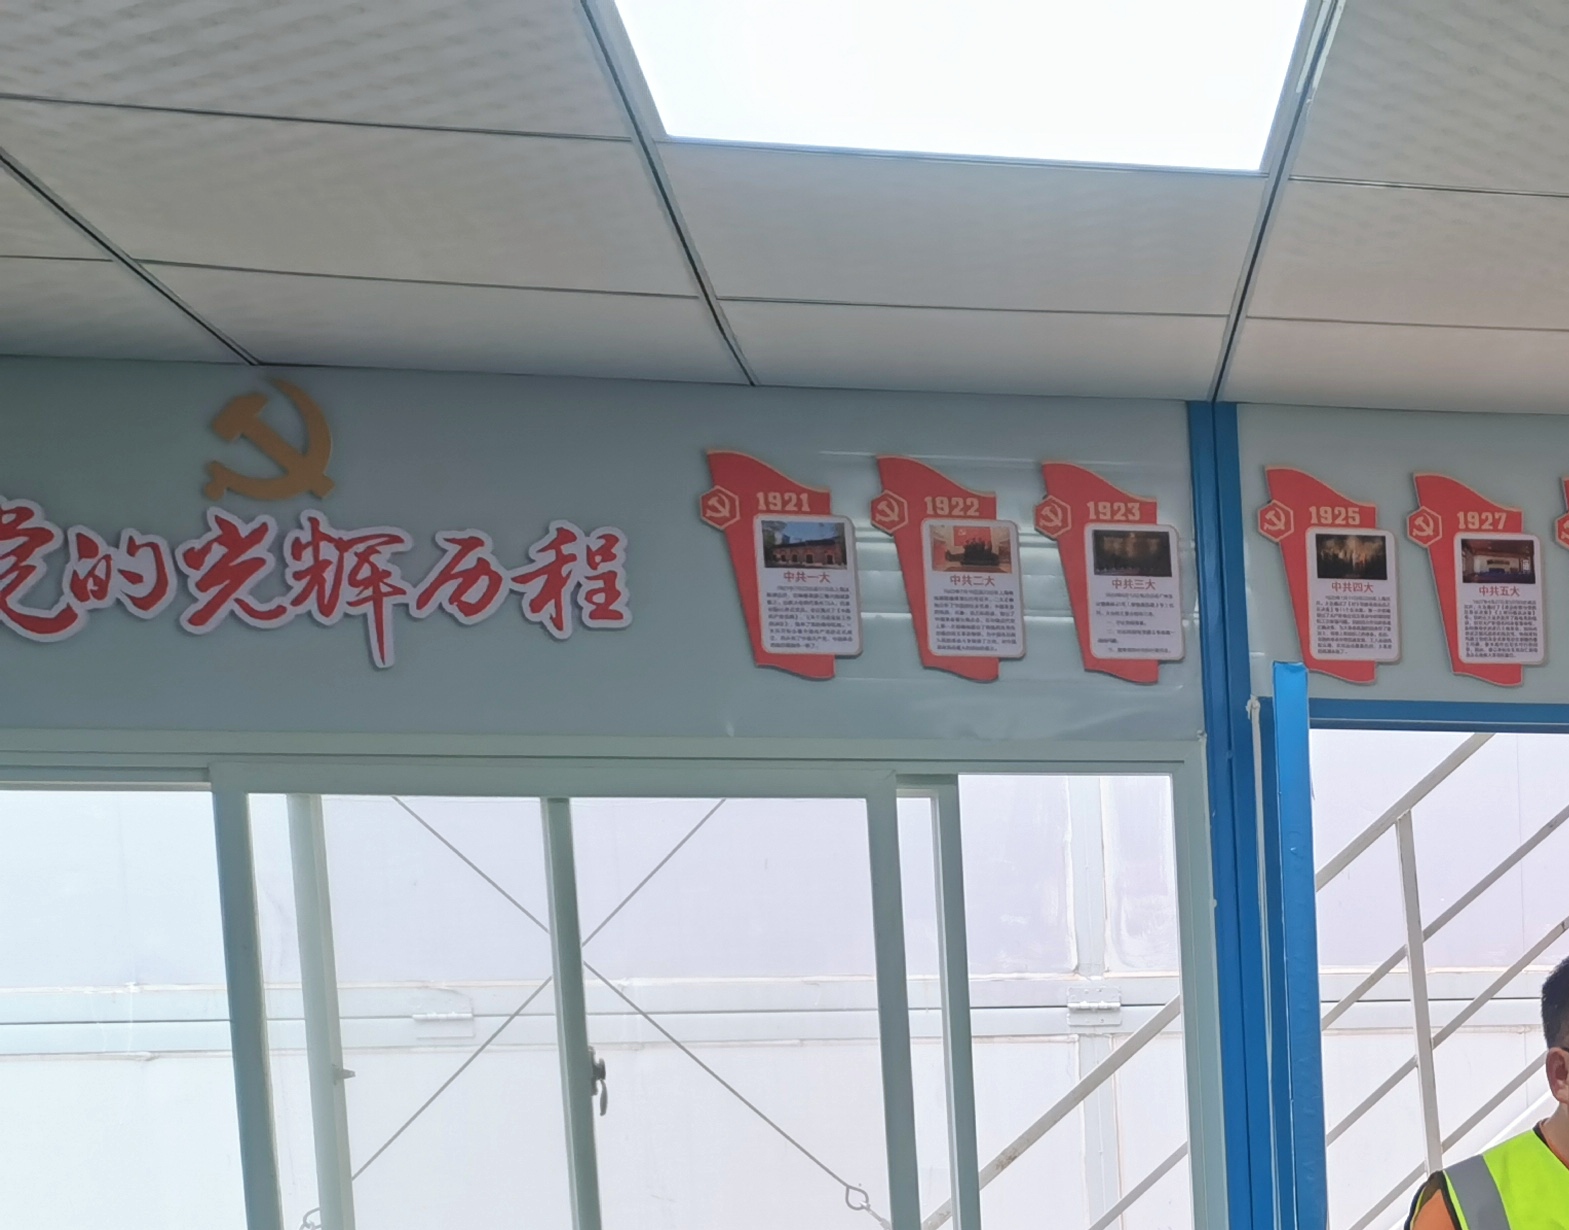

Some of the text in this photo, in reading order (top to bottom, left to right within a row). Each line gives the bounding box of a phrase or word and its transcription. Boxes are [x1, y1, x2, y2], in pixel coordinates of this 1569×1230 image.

[757, 492, 810, 512] 1921
[924, 496, 980, 517] 1922
[1086, 501, 1140, 521] 1923
[1309, 506, 1360, 525] 1925
[1457, 511, 1507, 530] 1927
[783, 571, 831, 583] 中共一大
[949, 573, 996, 588] 中共二大
[1112, 578, 1156, 590] 中共三大
[1331, 581, 1374, 593] 中共四大
[1478, 585, 1521, 598] 中共五大
